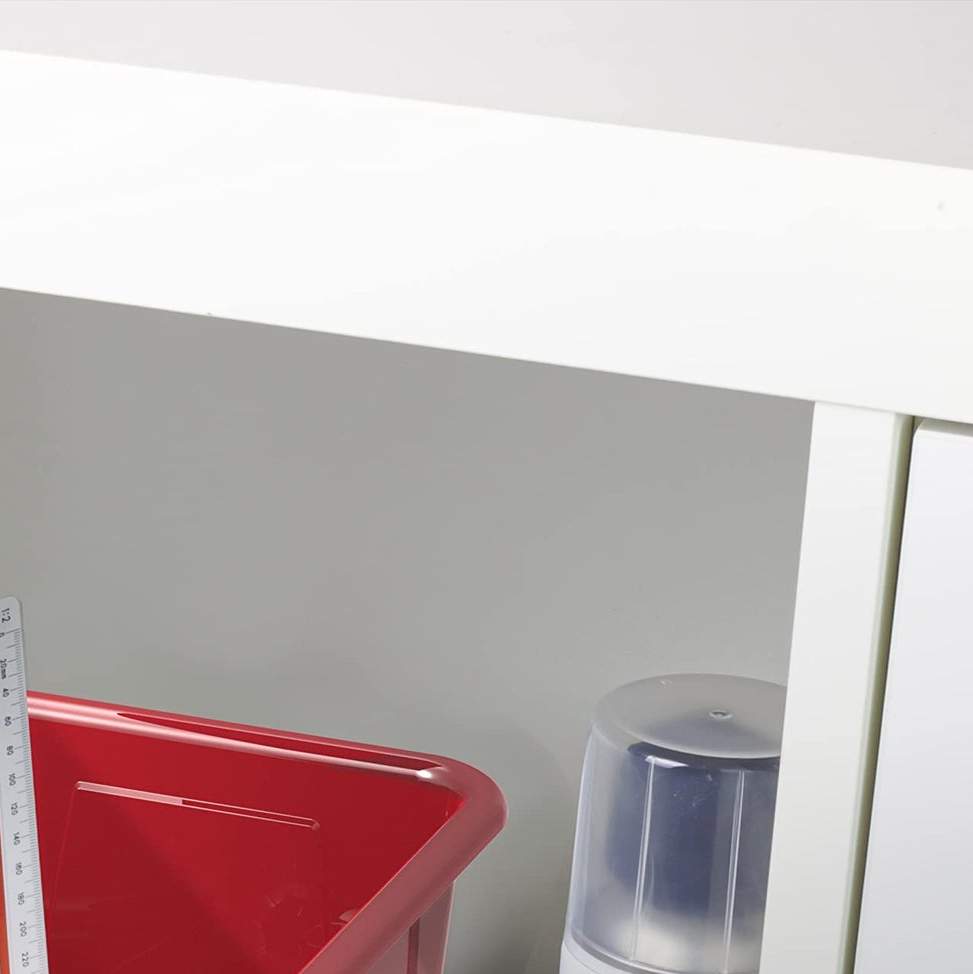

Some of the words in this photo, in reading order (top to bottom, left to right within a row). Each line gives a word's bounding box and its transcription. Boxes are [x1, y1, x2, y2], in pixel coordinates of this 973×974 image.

[2, 688, 10, 698] 40
[8, 772, 16, 786] 100
[10, 802, 18, 816] 120
[12, 832, 20, 846] 140
[22, 952, 30, 968] 220
